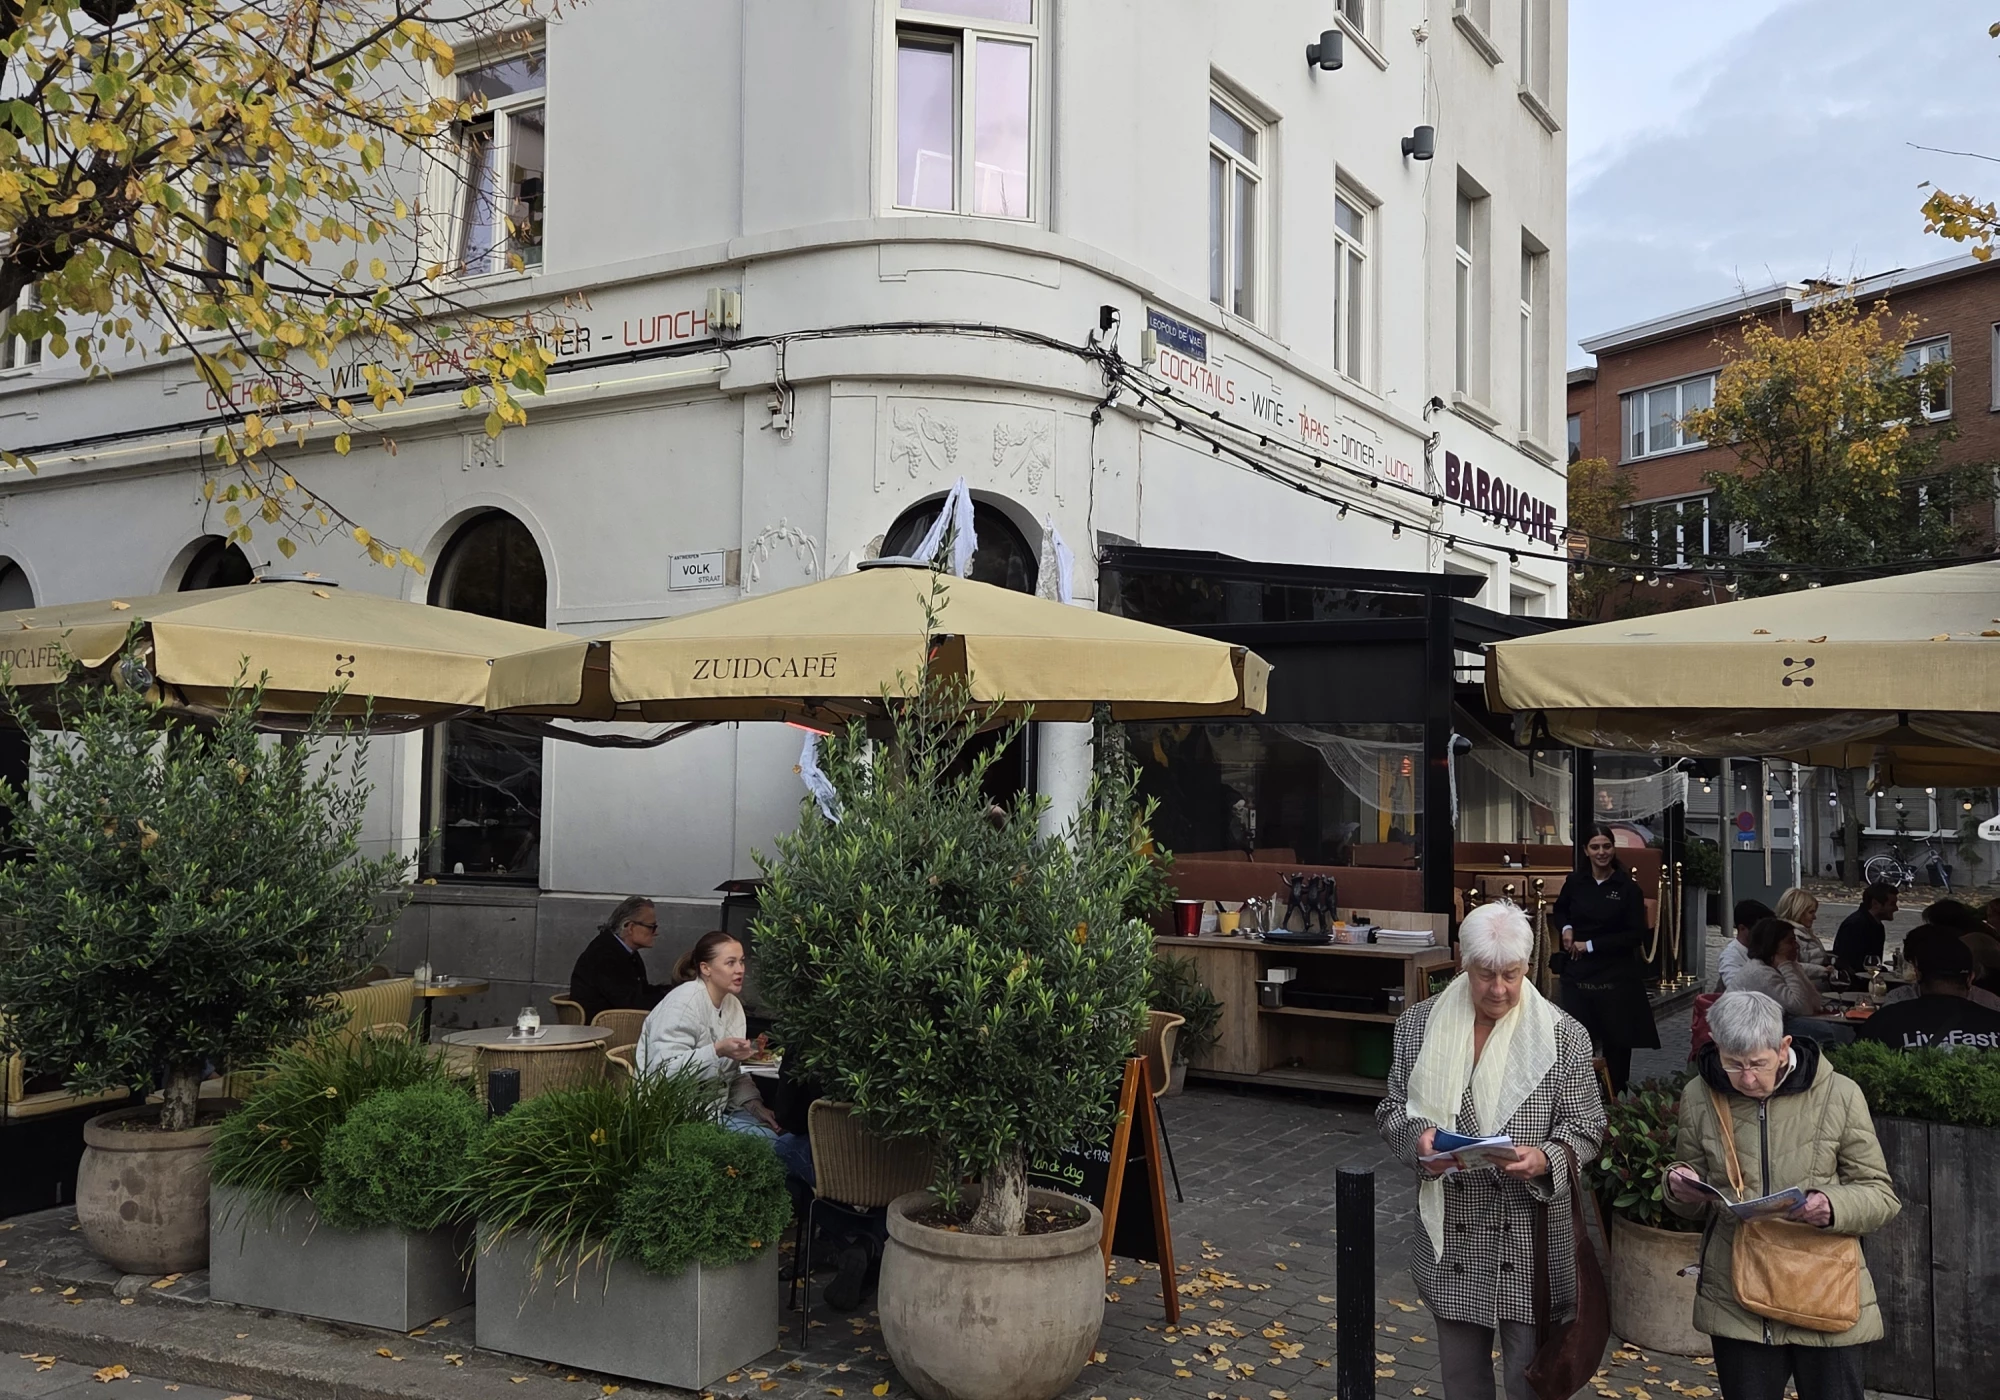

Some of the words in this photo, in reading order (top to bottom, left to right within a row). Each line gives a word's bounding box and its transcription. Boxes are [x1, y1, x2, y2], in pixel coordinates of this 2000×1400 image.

[623, 308, 708, 347] LUNCH
[1150, 316, 1177, 337] LEOPOLD
[1178, 330, 1187, 342] DE
[1160, 350, 1235, 405] COCKTAILS
[1251, 391, 1284, 427] WINE
[1299, 412, 1330, 447] TAPAS
[1341, 434, 1375, 468] DINNER
[1384, 454, 1414, 485] LUNCH
[1445, 450, 1557, 545] BAROUCHE
[682, 563, 710, 576] VOLK
[698, 575, 721, 583] STRAAT
[692, 652, 838, 680] ZUIDCAFÉ
[1063, 1162, 1084, 1184] dag
